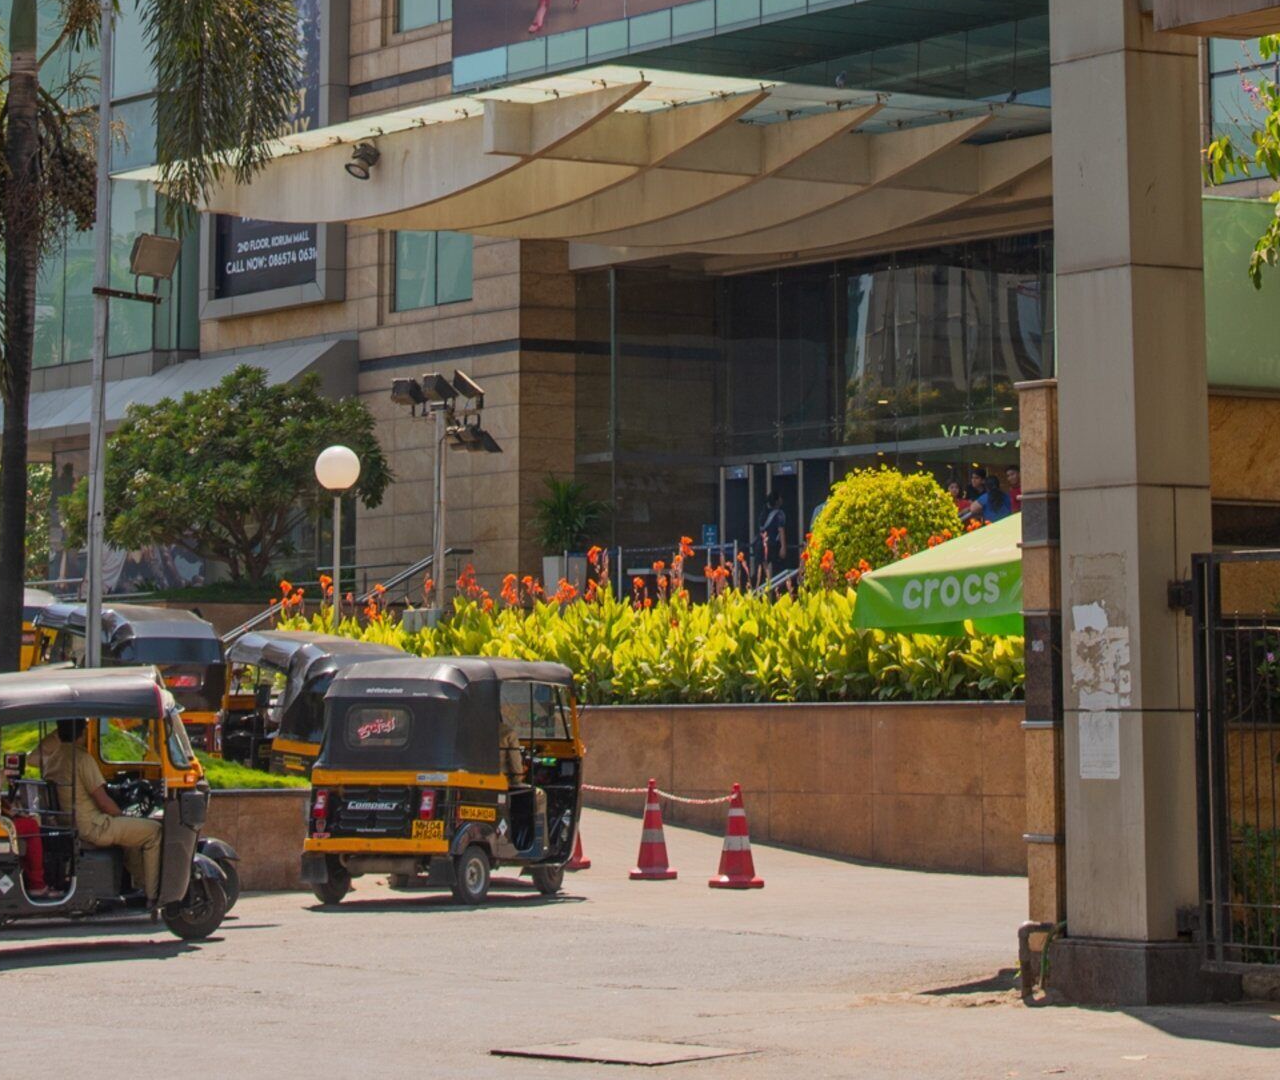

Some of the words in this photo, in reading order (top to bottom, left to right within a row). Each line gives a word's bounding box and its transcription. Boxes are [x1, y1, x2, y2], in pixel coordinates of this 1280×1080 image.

[226, 259, 245, 275] CALL
[246, 255, 268, 271] NOW:
[902, 571, 1001, 610] crocs
